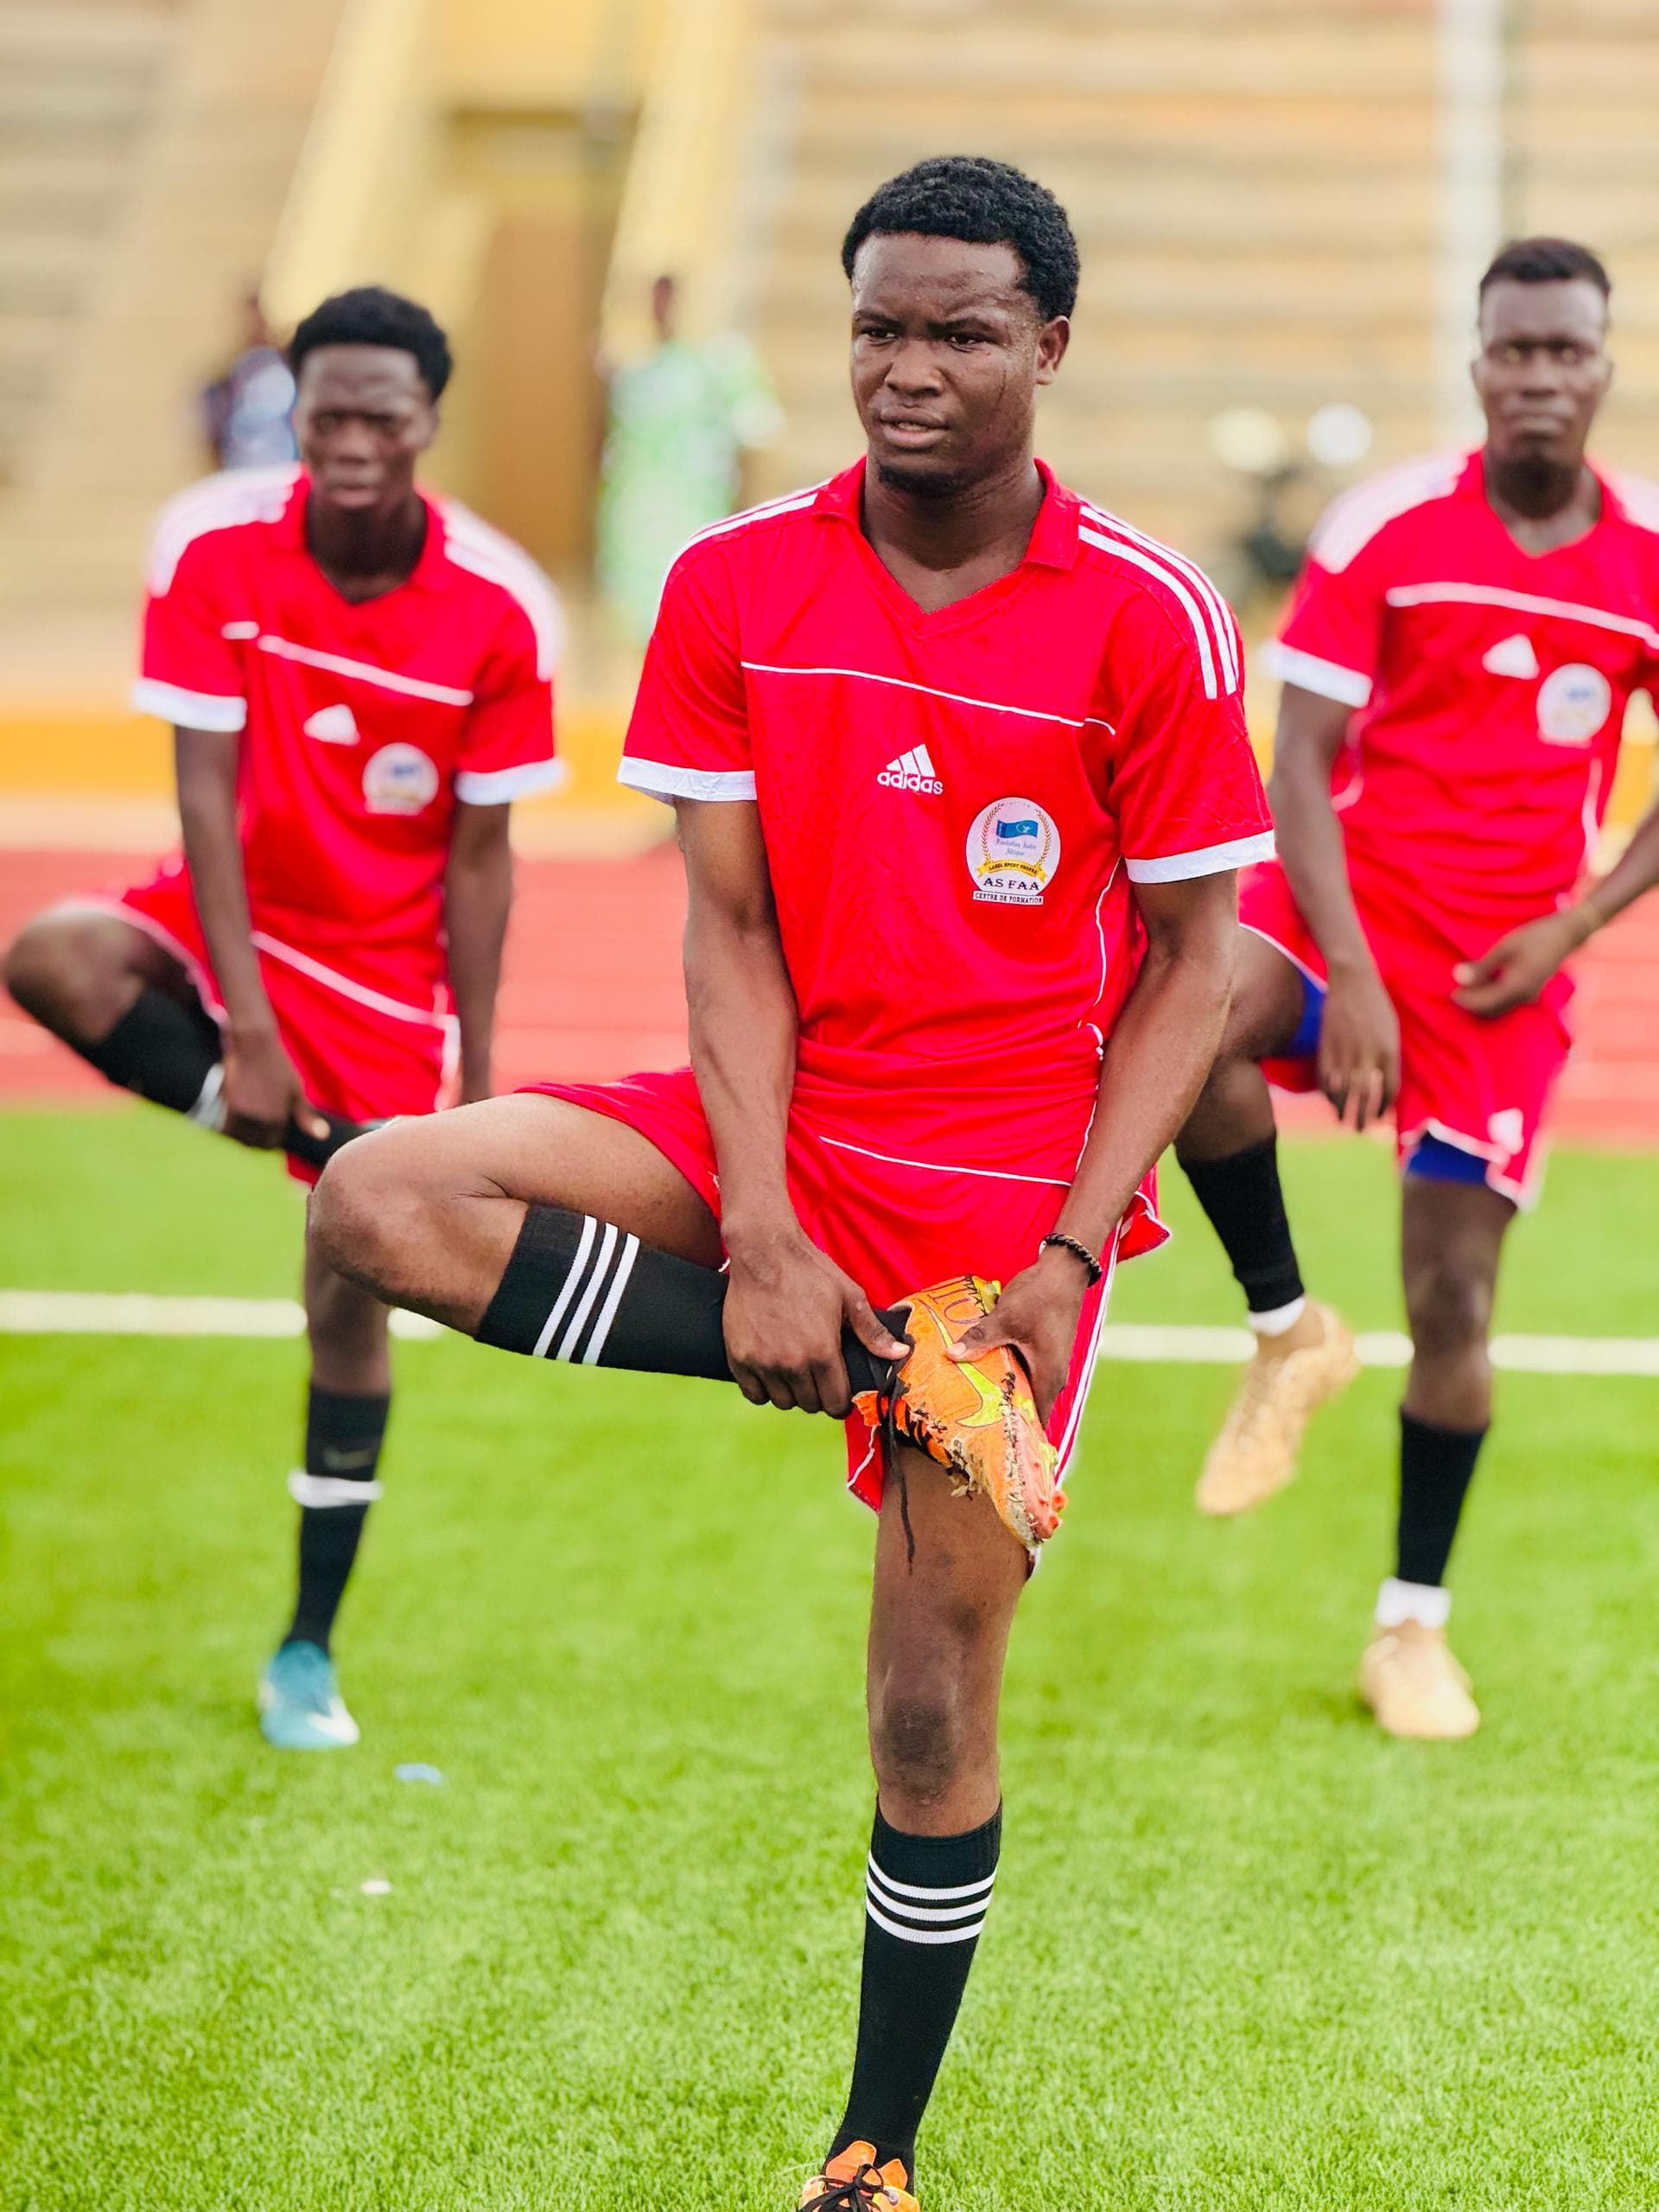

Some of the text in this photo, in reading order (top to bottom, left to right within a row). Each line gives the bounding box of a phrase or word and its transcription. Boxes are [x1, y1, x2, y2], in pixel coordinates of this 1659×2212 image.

[877, 770, 944, 794] adidas
[983, 877, 1039, 890] AS FAA
